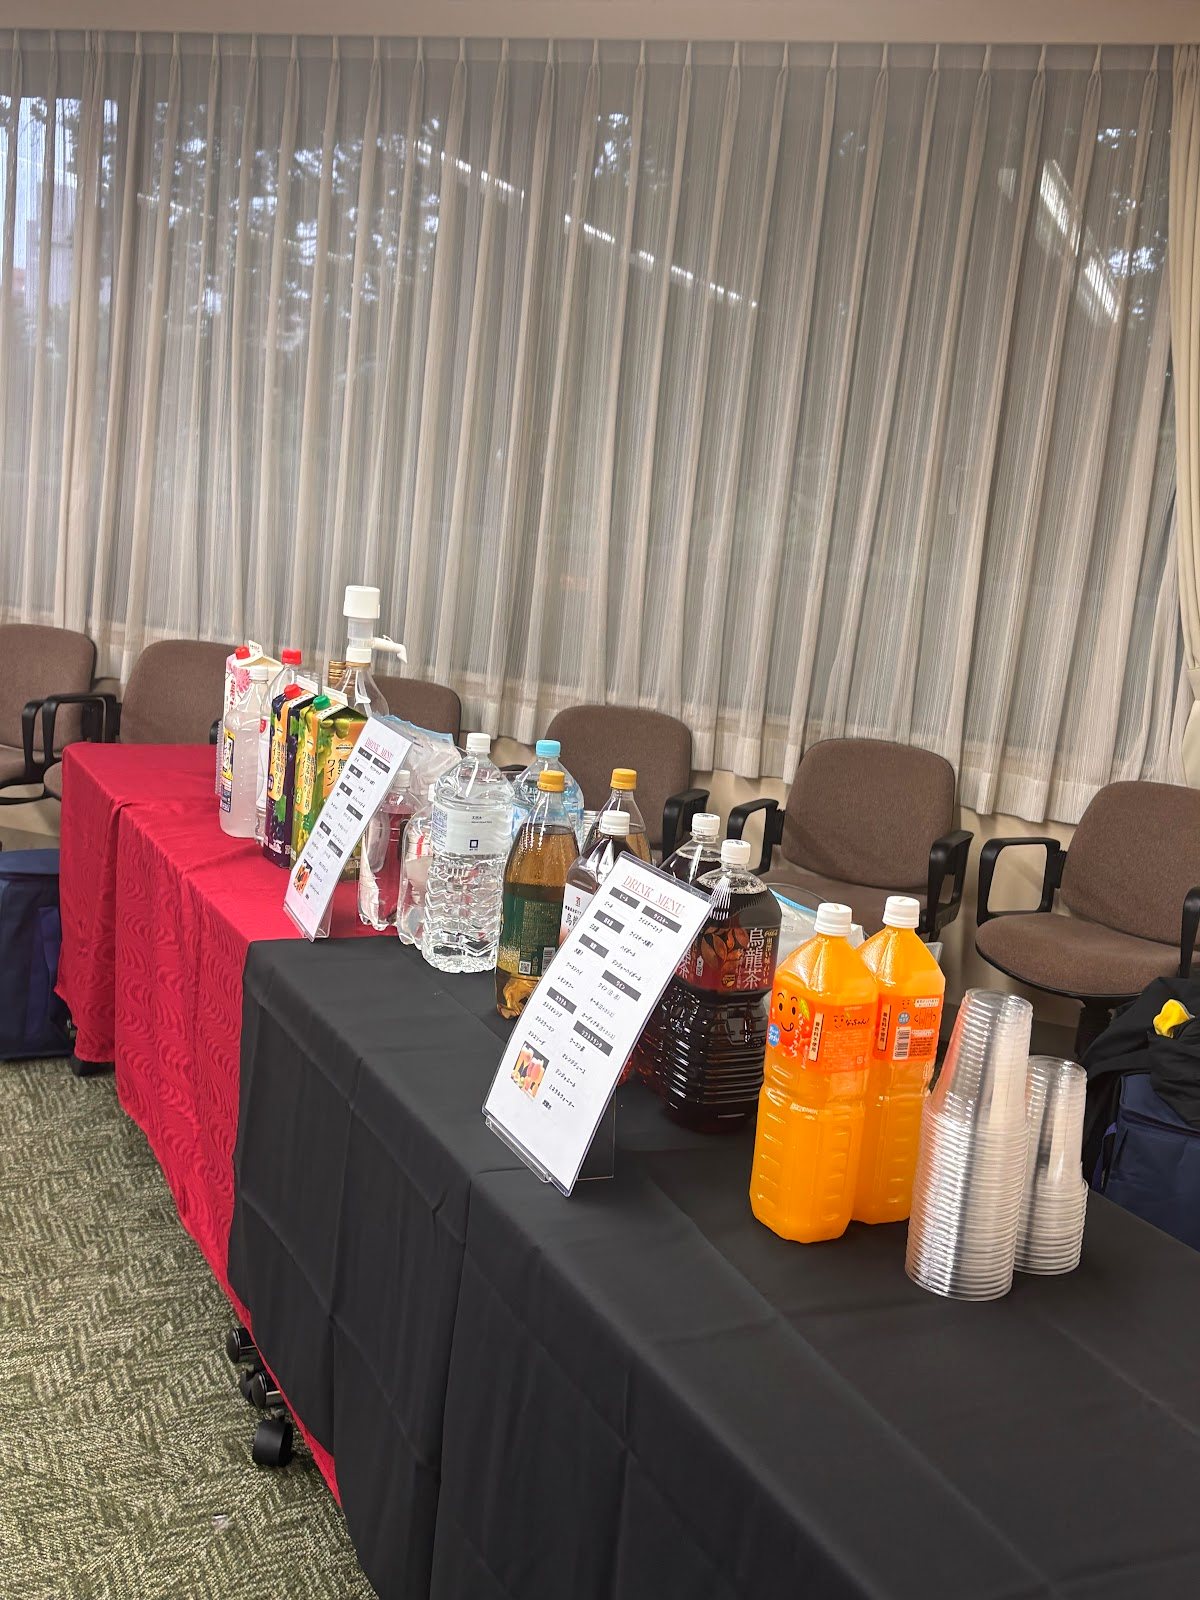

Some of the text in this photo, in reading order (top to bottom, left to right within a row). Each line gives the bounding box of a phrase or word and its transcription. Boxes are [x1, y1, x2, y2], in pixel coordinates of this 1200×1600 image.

[327, 759, 336, 786] ワイン
[623, 875, 685, 914] DRINK MENU
[743, 928, 764, 989] 烏龍茶
